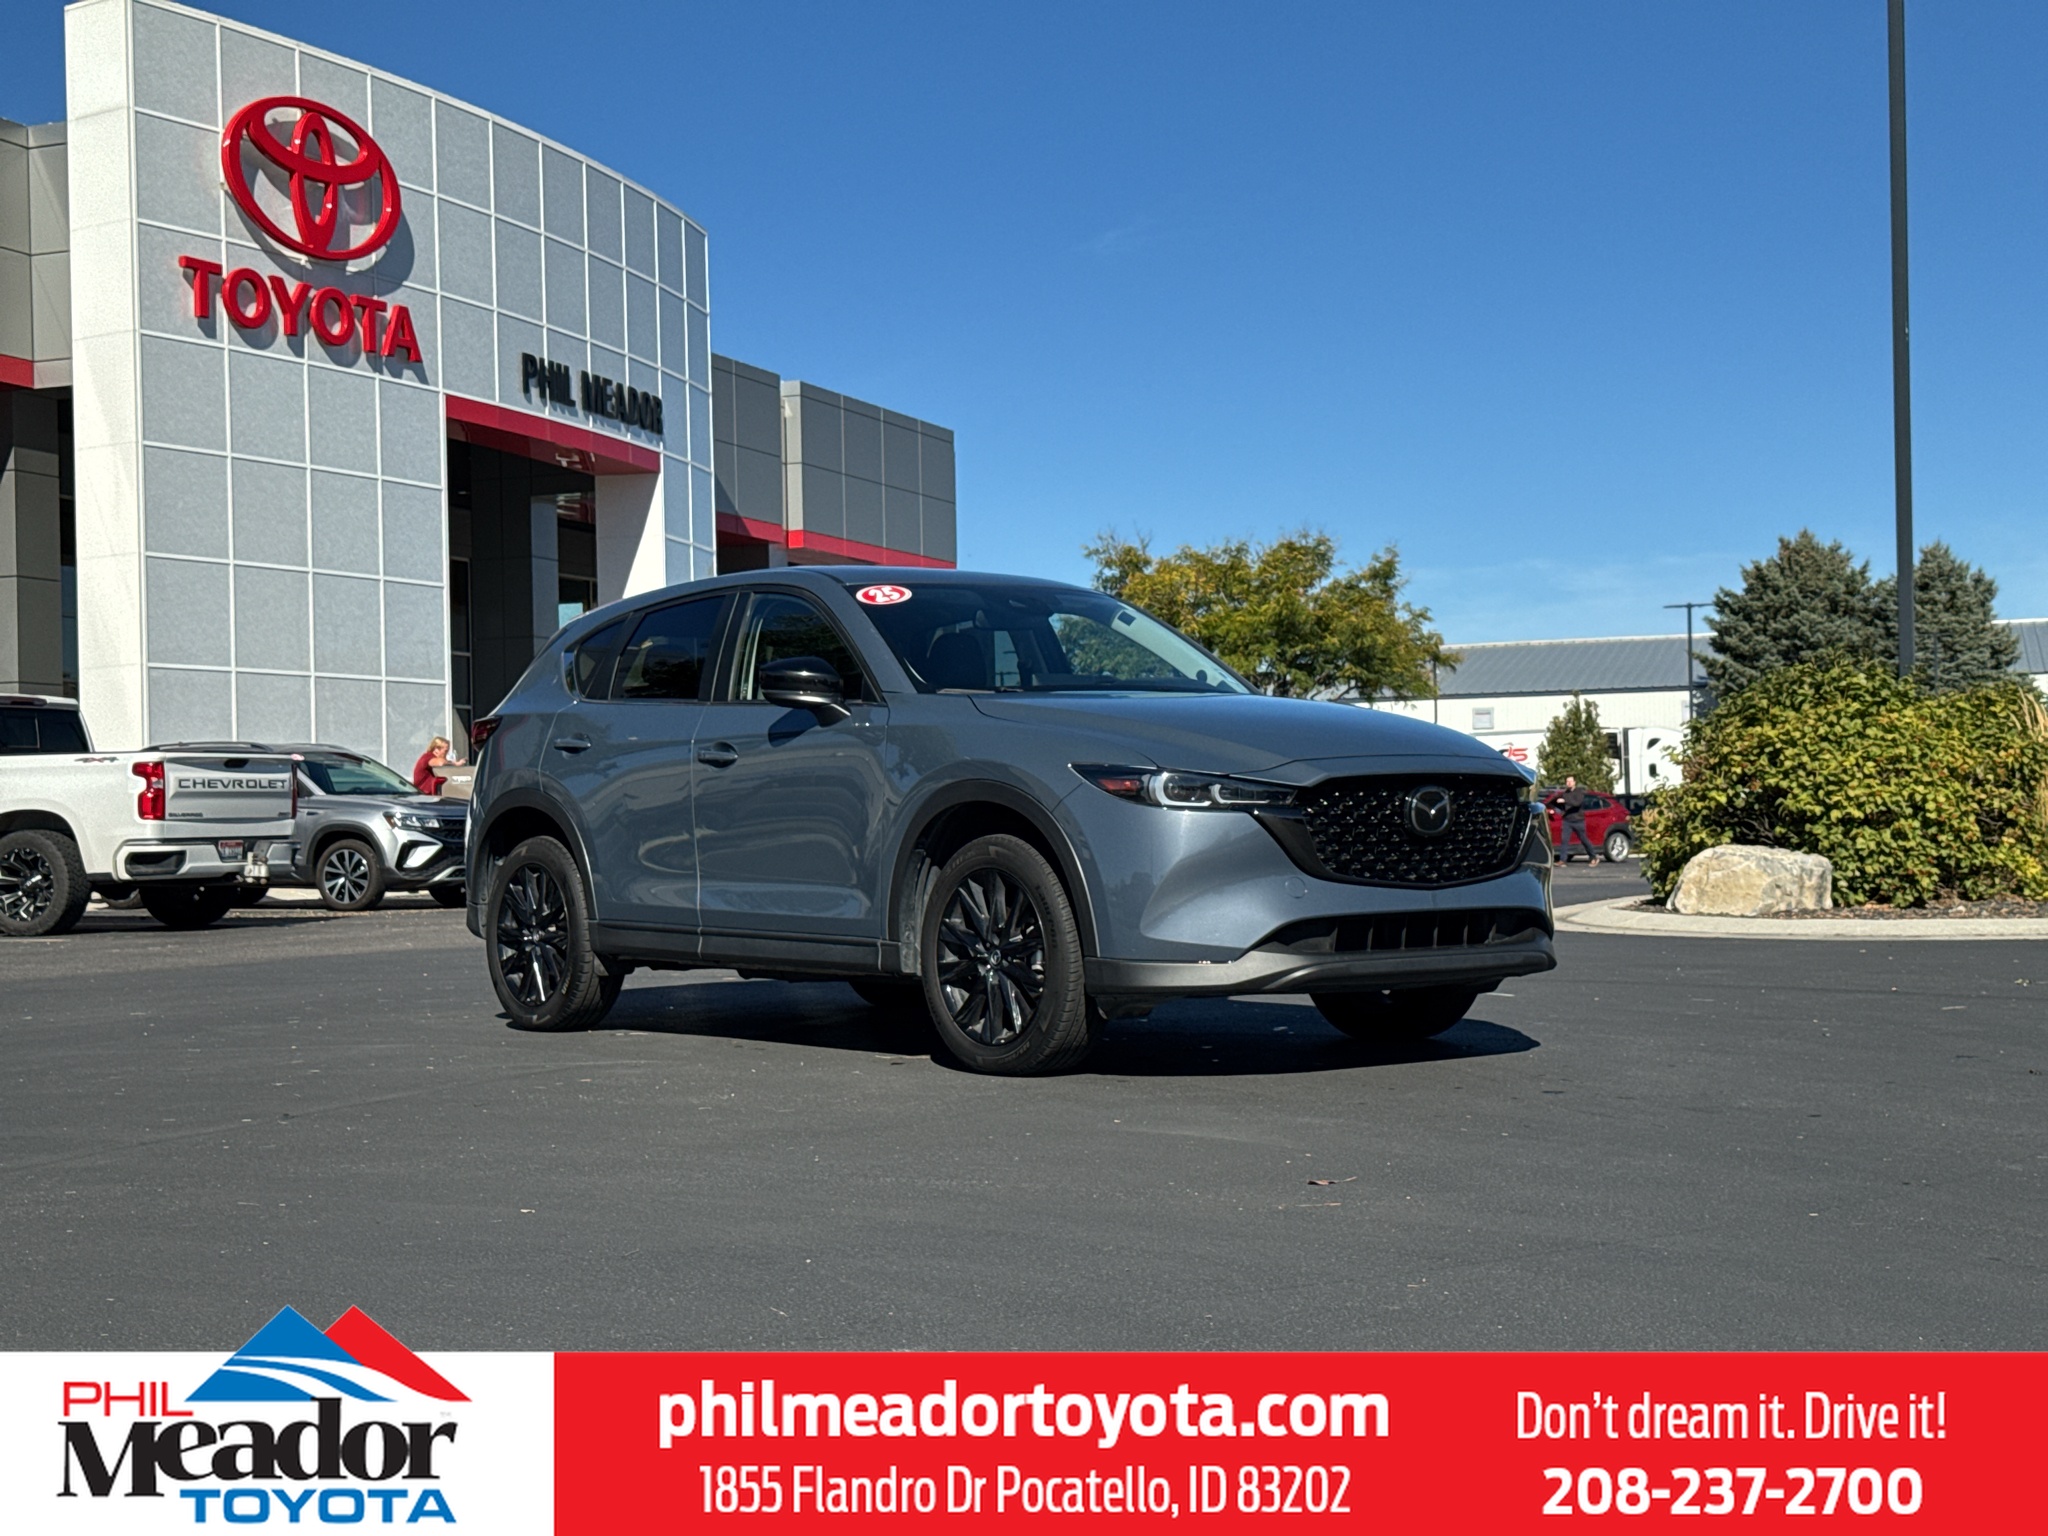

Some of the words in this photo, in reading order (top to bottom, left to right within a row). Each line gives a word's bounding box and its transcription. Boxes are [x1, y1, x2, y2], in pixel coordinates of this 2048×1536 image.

[179, 256, 422, 363] TOYOTA
[522, 352, 576, 407] PHIL
[580, 370, 664, 435] MEADOR
[868, 586, 901, 603] 25
[178, 778, 288, 790] CHEVROLET
